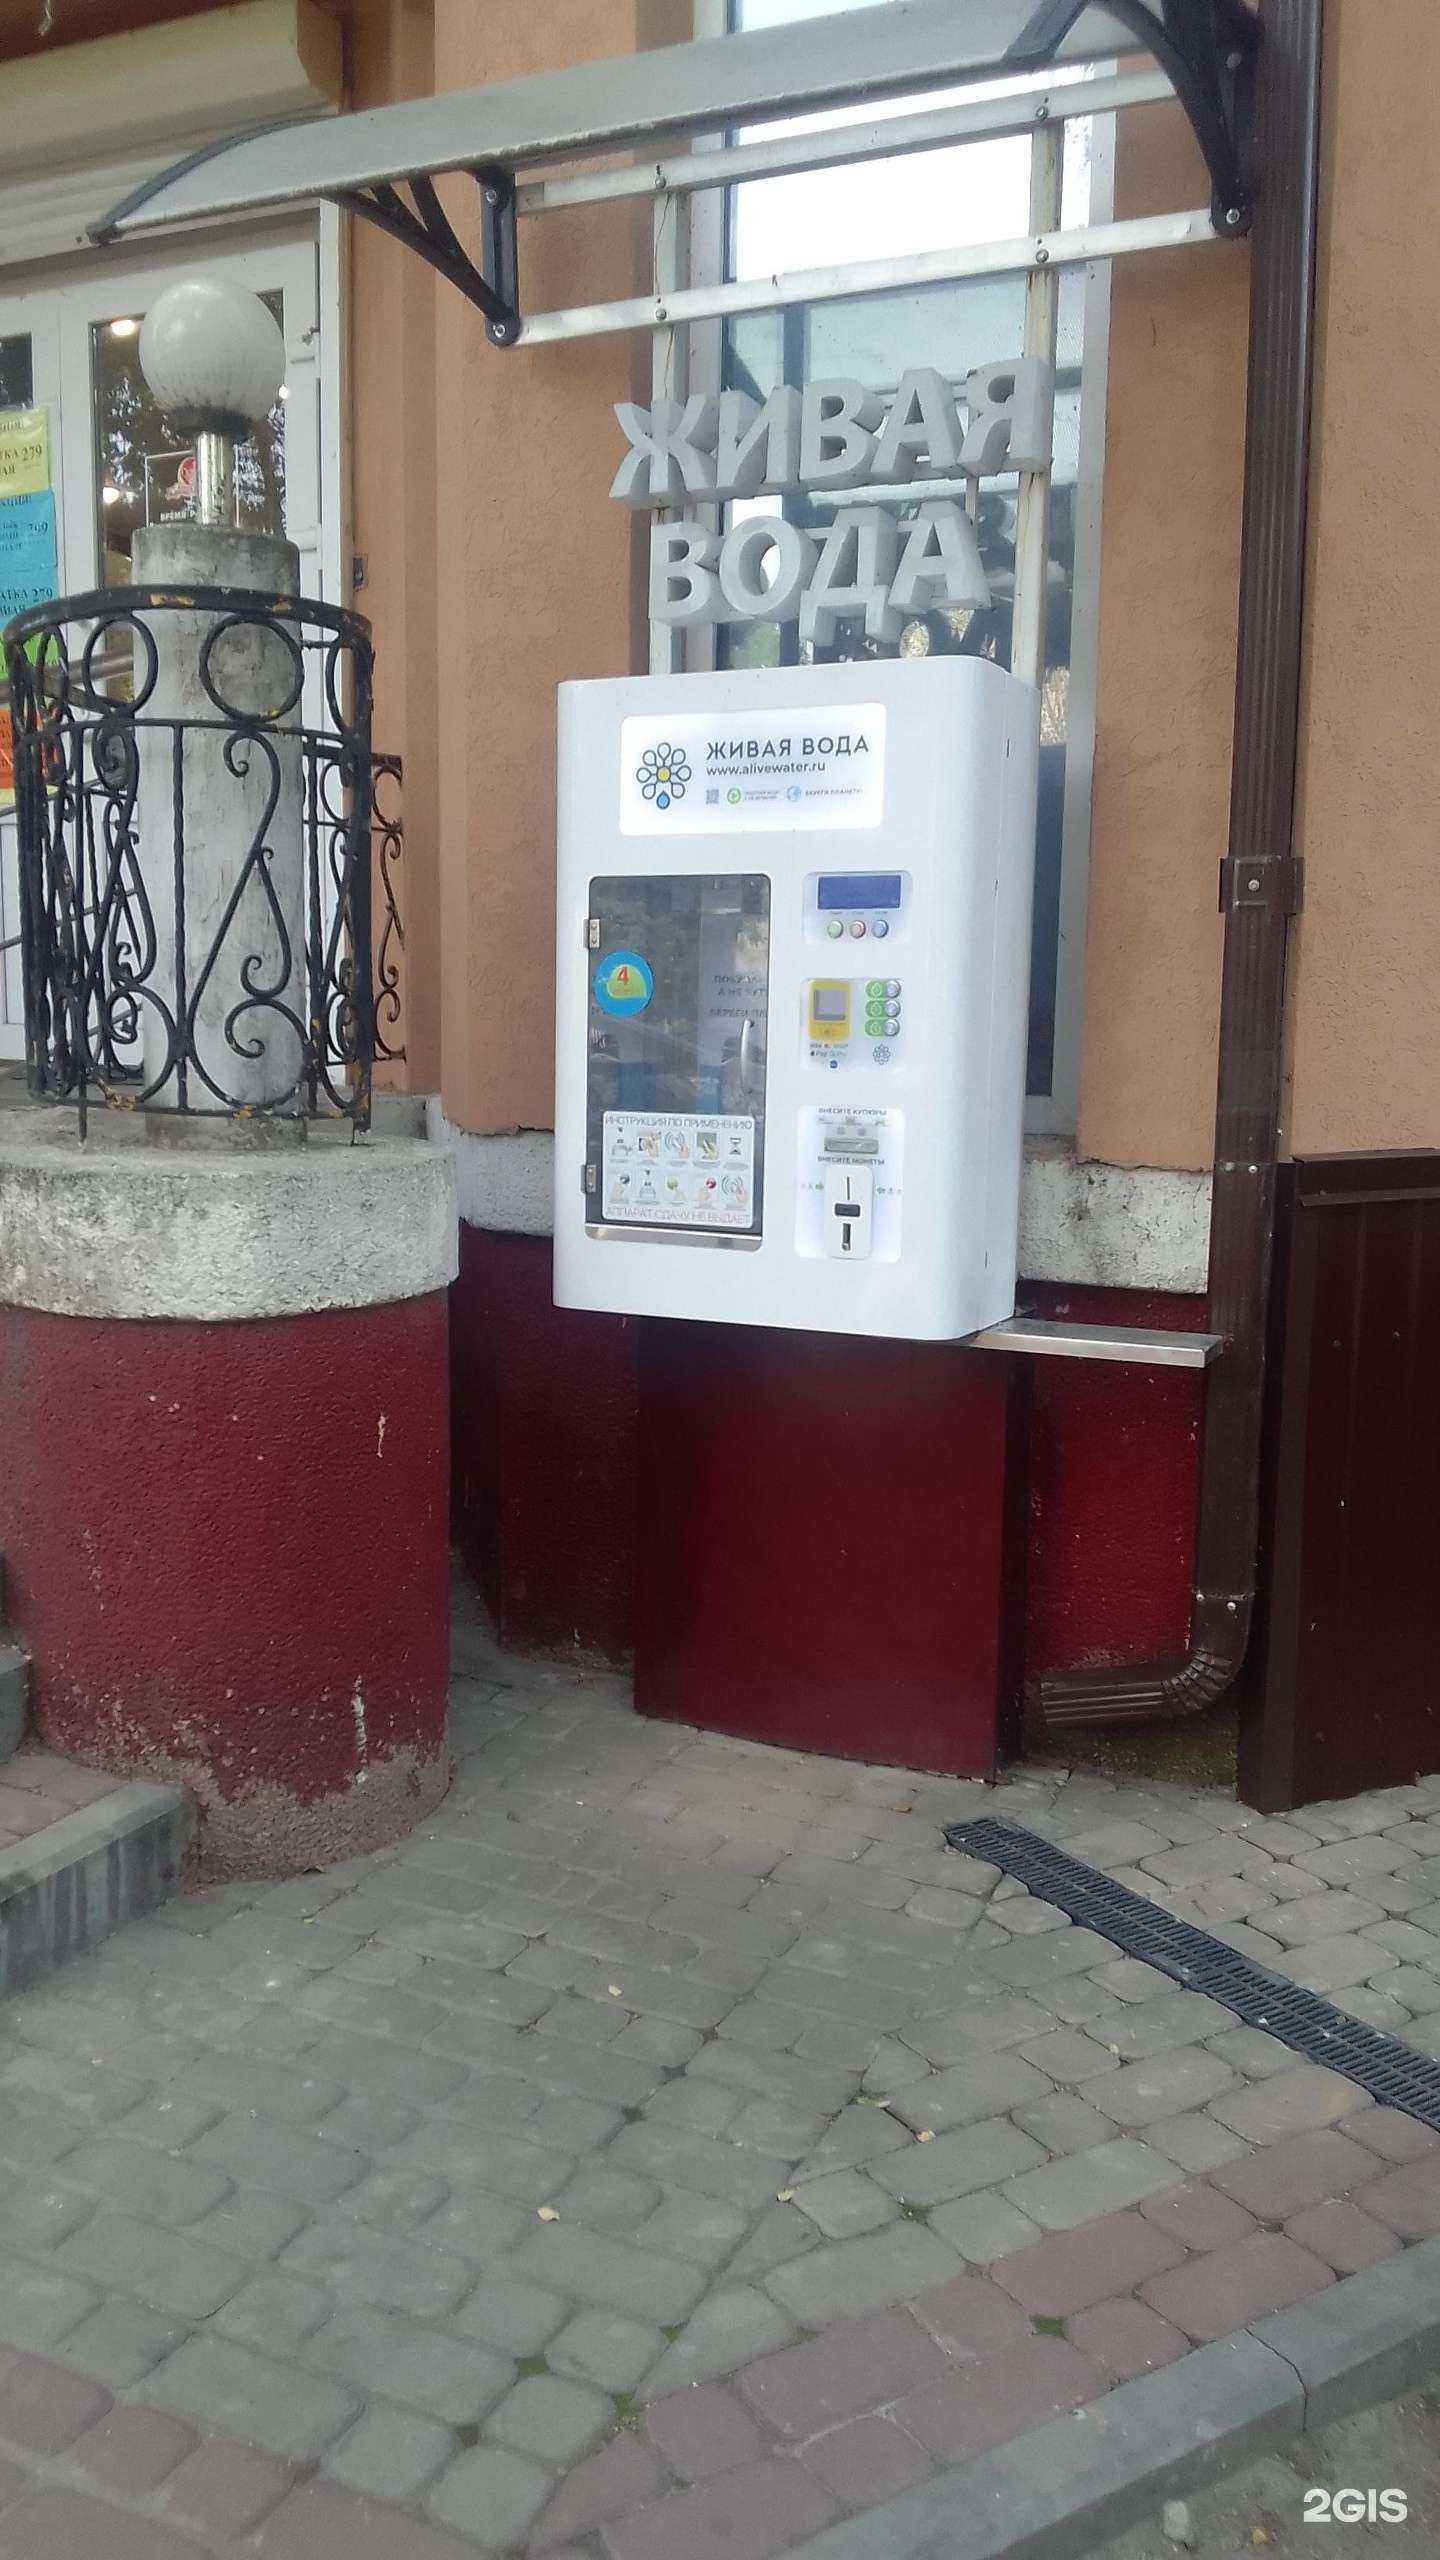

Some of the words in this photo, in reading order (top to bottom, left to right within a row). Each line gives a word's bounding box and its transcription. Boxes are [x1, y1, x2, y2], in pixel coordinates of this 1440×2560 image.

[608, 358, 1052, 509] ЖИВАЯ
[649, 500, 992, 646] ВОДА
[706, 738, 792, 760] ЖИВАЯ
[802, 735, 869, 756] ВОДА
[706, 761, 825, 776] www.alivewater.ru
[617, 966, 629, 985] 4
